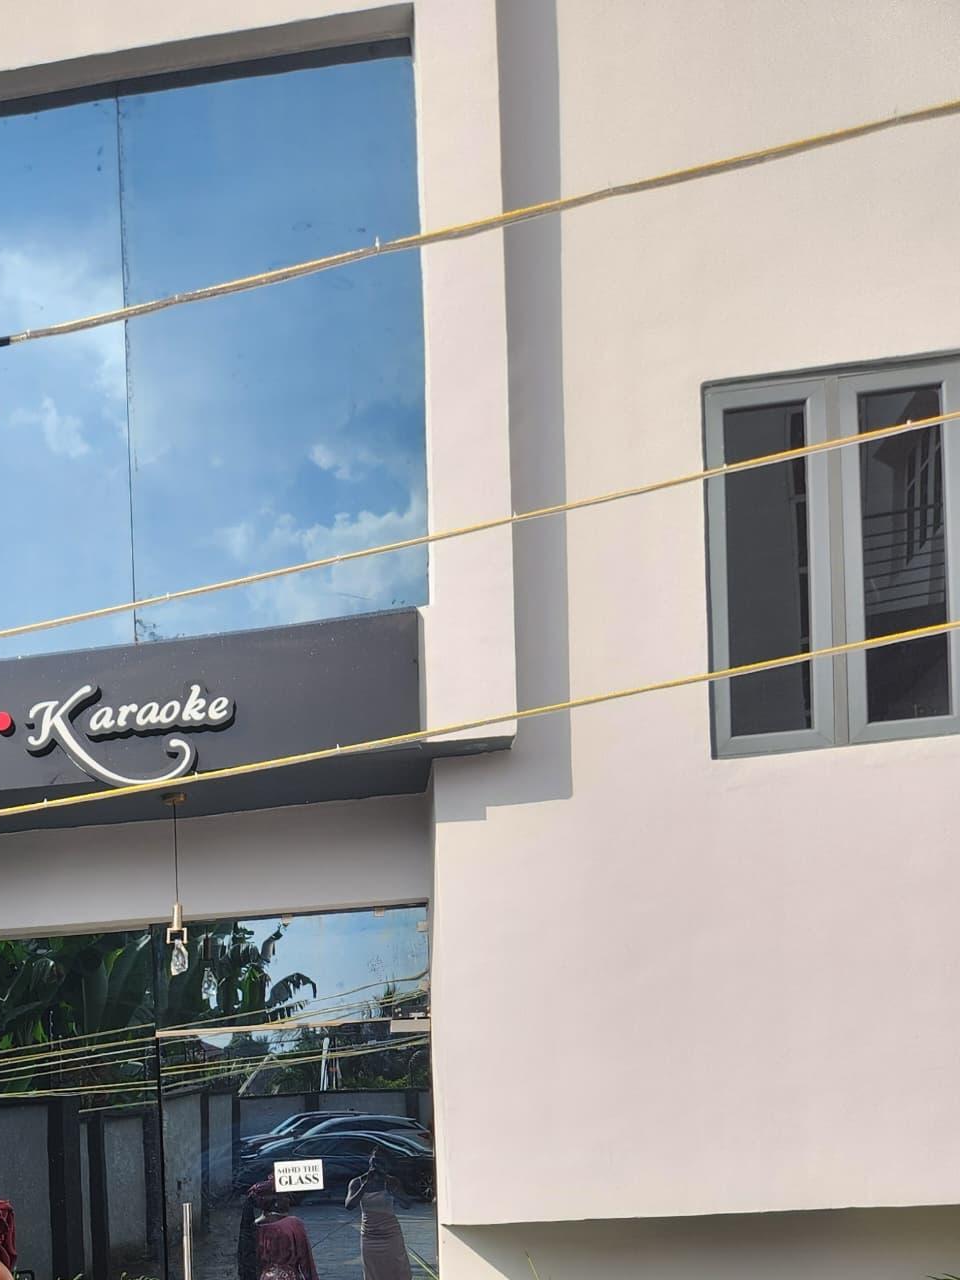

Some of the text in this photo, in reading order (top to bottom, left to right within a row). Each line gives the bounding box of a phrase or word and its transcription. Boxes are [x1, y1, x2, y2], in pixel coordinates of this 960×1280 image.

[27, 683, 233, 787] Karaoke
[304, 1165, 319, 1173] THE
[278, 1173, 319, 1186] GLASS
